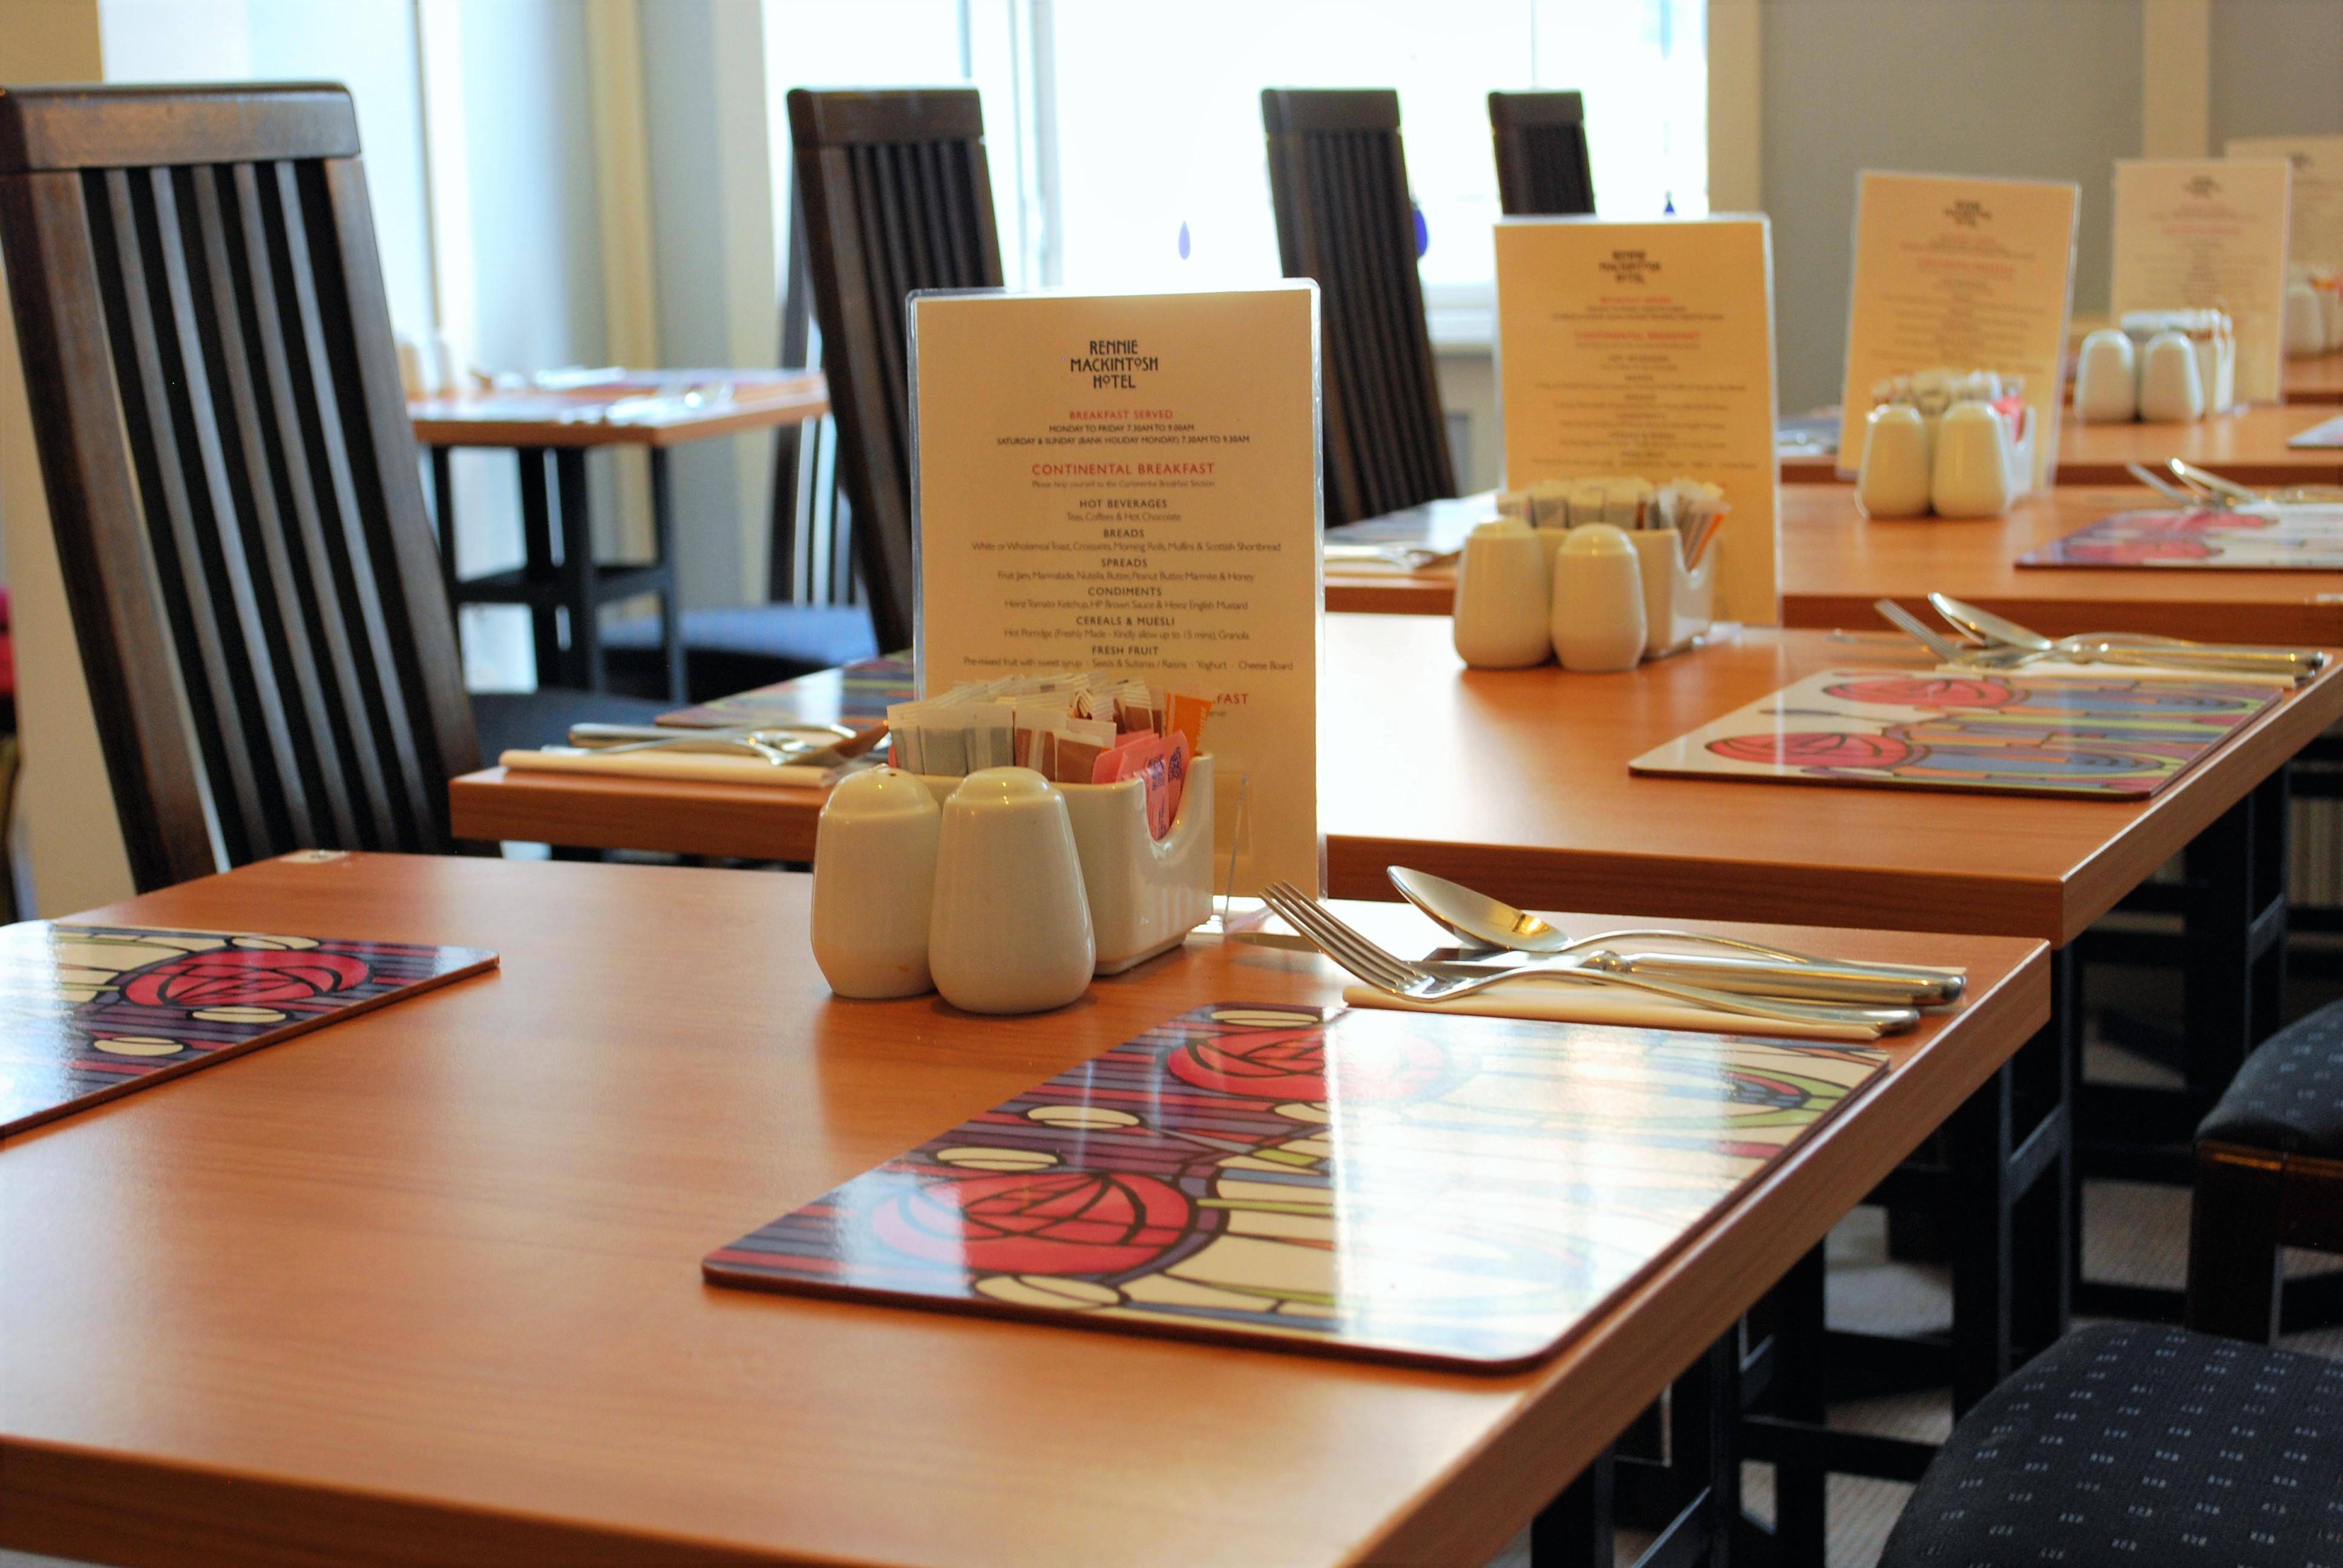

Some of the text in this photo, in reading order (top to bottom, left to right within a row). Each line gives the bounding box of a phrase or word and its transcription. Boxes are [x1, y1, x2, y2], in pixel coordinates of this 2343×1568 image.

[1089, 341, 1138, 355] RENNIE
[1070, 358, 1158, 372] MACKINTOSH
[1093, 375, 1136, 388] HOTEL
[1069, 410, 1173, 420] BREAKFAST SERVED
[1032, 463, 1214, 475] CONTINENTAL BREAKFAST
[1080, 499, 1167, 508] HOT BEVERAGES
[1115, 512, 1122, 521] &
[1142, 512, 1181, 521] Chocolate
[1103, 529, 1144, 538] BREADS
[971, 541, 997, 550] White
[1101, 558, 1148, 567] SPREADS
[1227, 573, 1254, 582] Honey
[1087, 587, 1162, 596] CONDIMENTS
[1156, 600, 1162, 609] &
[1076, 616, 1122, 626] CEREALS
[1137, 617, 1175, 626] MUESLI
[1092, 645, 1159, 655] FRESH FRUIT
[1196, 661, 1227, 671] Yoghurt
[1238, 661, 1268, 670] Cheese
[1270, 661, 1293, 670] Board
